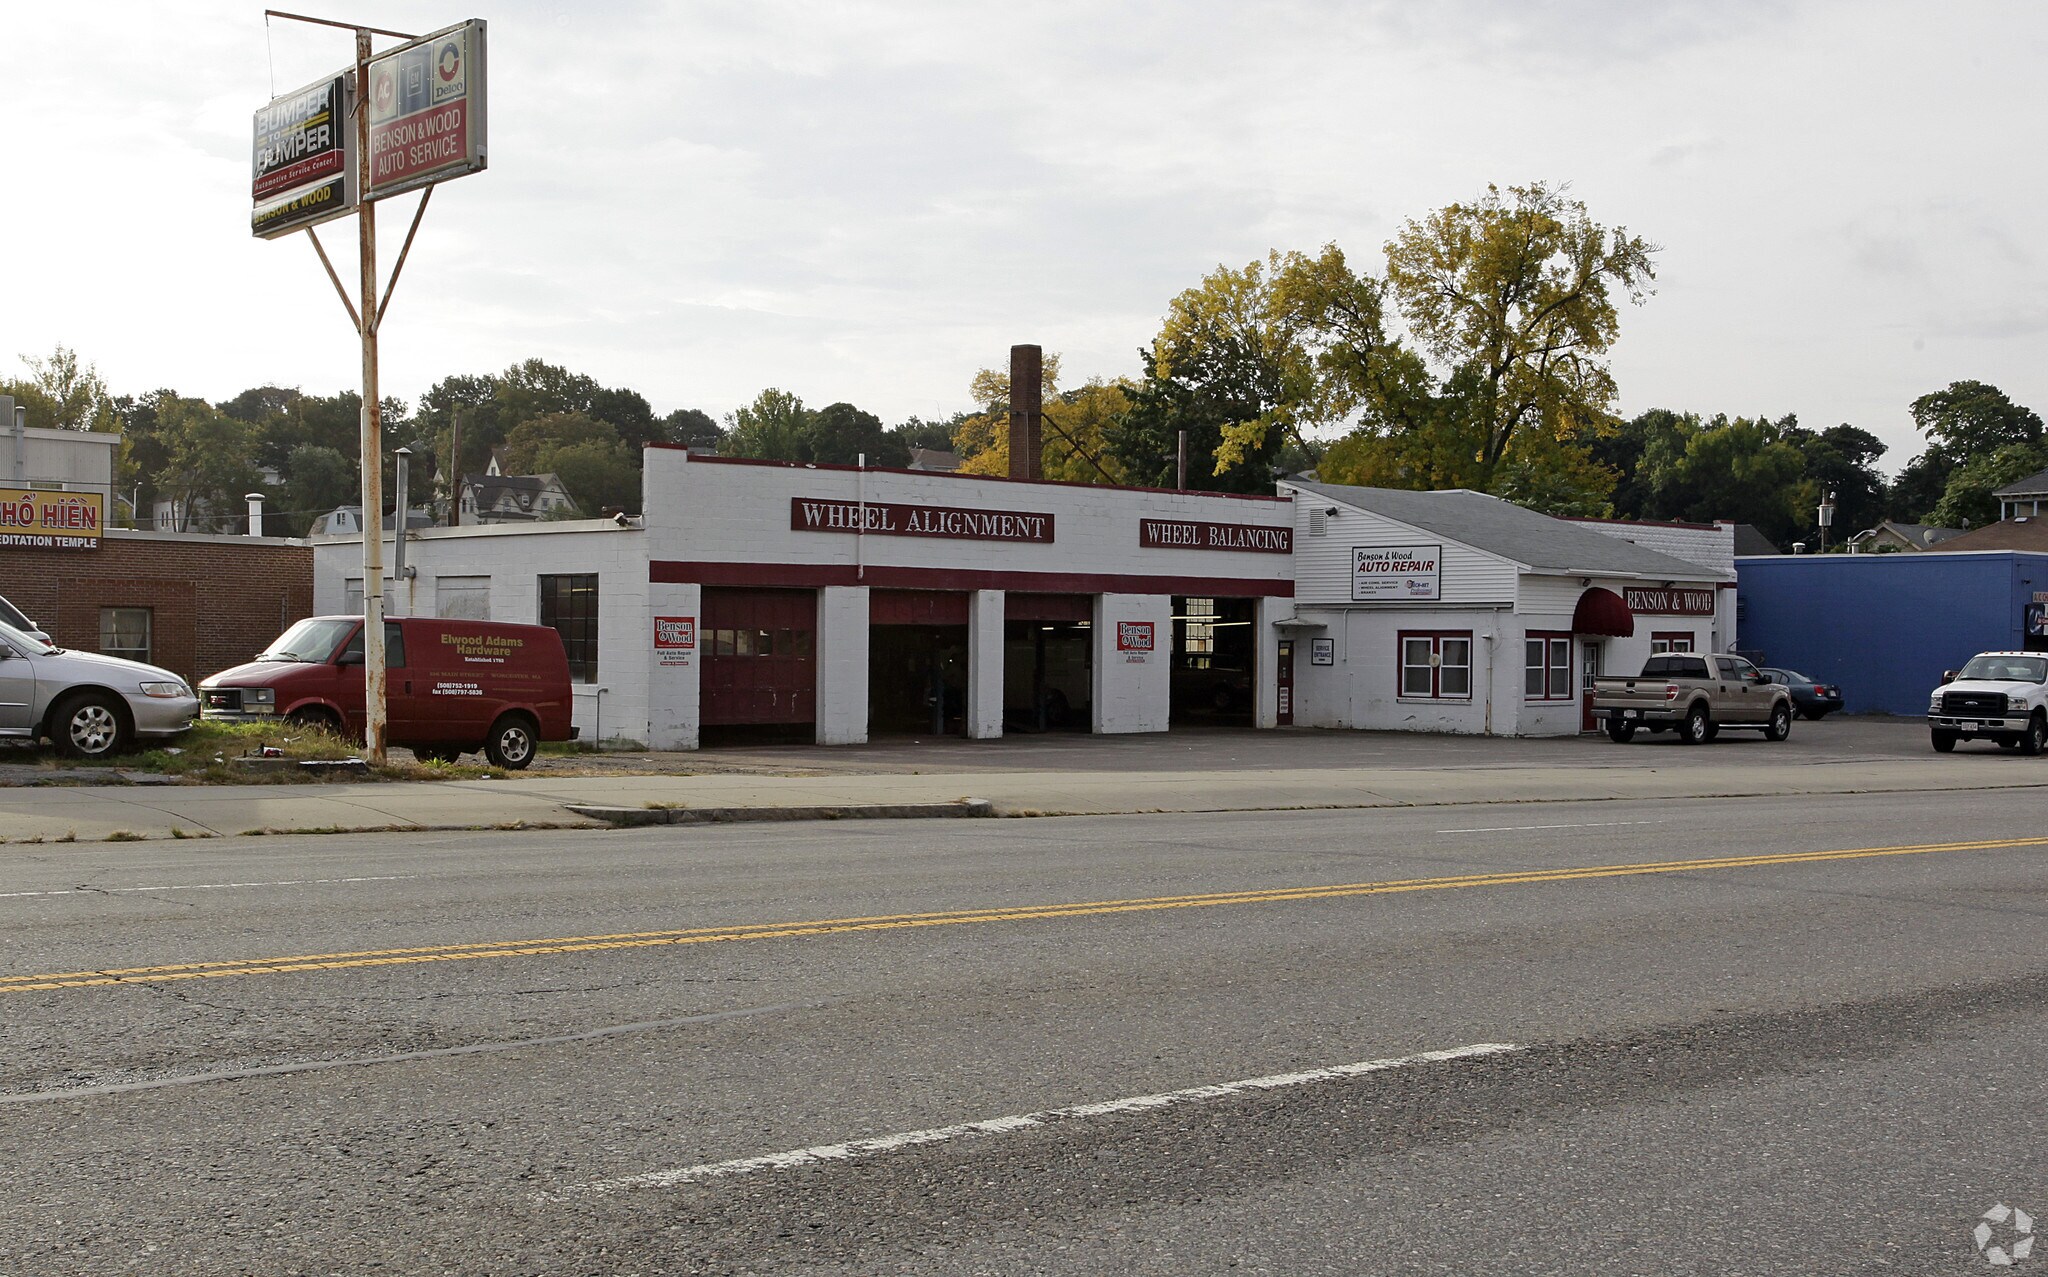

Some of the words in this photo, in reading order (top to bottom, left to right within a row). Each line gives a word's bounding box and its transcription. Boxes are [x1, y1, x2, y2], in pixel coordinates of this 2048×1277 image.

[377, 81, 390, 101] AC
[436, 82, 463, 98] Delco
[257, 84, 329, 136] BUMPER
[267, 132, 280, 142] TO
[374, 123, 416, 155] BENSON
[417, 122, 425, 140] &
[425, 108, 461, 137] WOOD
[378, 150, 405, 177] AUTO
[410, 133, 457, 166] SERVICE
[255, 174, 287, 191] Automotive
[288, 165, 311, 179] Service
[312, 158, 333, 171] Center
[291, 199, 299, 211] &
[300, 186, 331, 208] WOOD
[0, 493, 37, 527] HỔ
[801, 502, 896, 531] WHEEL
[905, 510, 1046, 539] ALIGNMENT
[0, 534, 53, 547] DITATION
[55, 536, 97, 549] TEMPLE
[1147, 522, 1201, 545] WHEEL
[1208, 526, 1288, 550] BALANCING
[1357, 551, 1383, 562] Benson
[1385, 551, 1390, 560] &
[1391, 550, 1413, 560] Wood
[1357, 561, 1390, 573] AUTO
[1391, 560, 1435, 572] REPAIR
[1627, 591, 1668, 610] BENSON
[1672, 592, 1680, 610] &
[1684, 592, 1711, 611] WOOD
[657, 620, 693, 631] Benson
[1120, 623, 1151, 635] Benson
[441, 633, 483, 645] Elwood
[486, 635, 524, 647] Adams
[667, 631, 693, 643] Wood
[1130, 636, 1152, 647] Wood
[457, 644, 511, 656] Hardware
